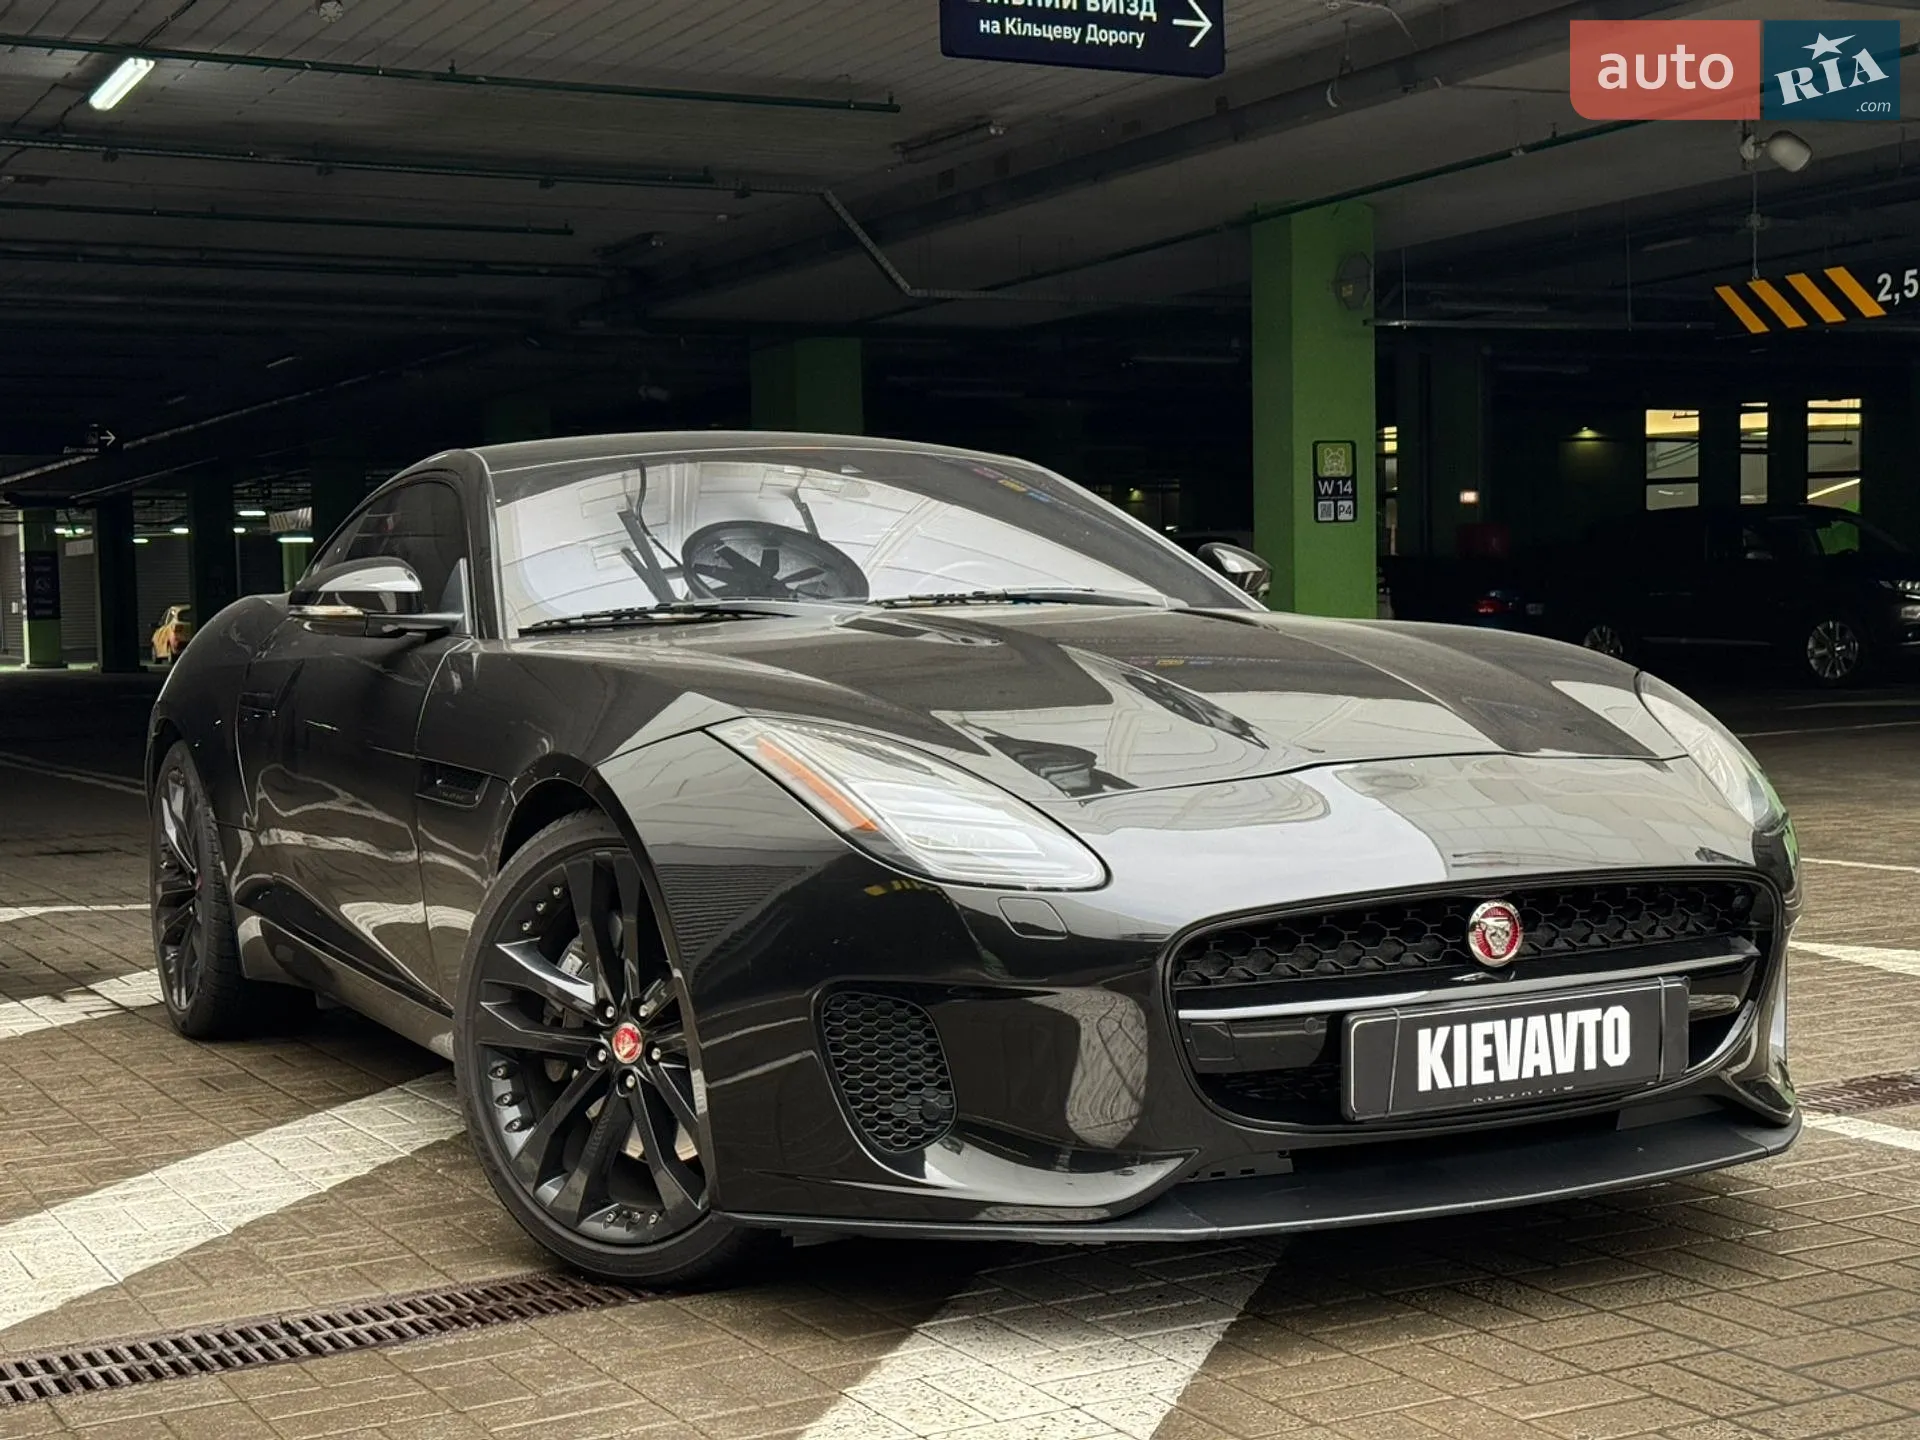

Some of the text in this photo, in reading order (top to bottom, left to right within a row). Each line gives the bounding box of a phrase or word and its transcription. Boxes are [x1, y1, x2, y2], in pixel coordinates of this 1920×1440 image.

[979, 17, 1145, 48] на Кільцеву Дорогу
[1877, 268, 1920, 305] 2,5
[1318, 480, 1353, 495] W 14
[1417, 1005, 1631, 1092] KIEVAVTO
